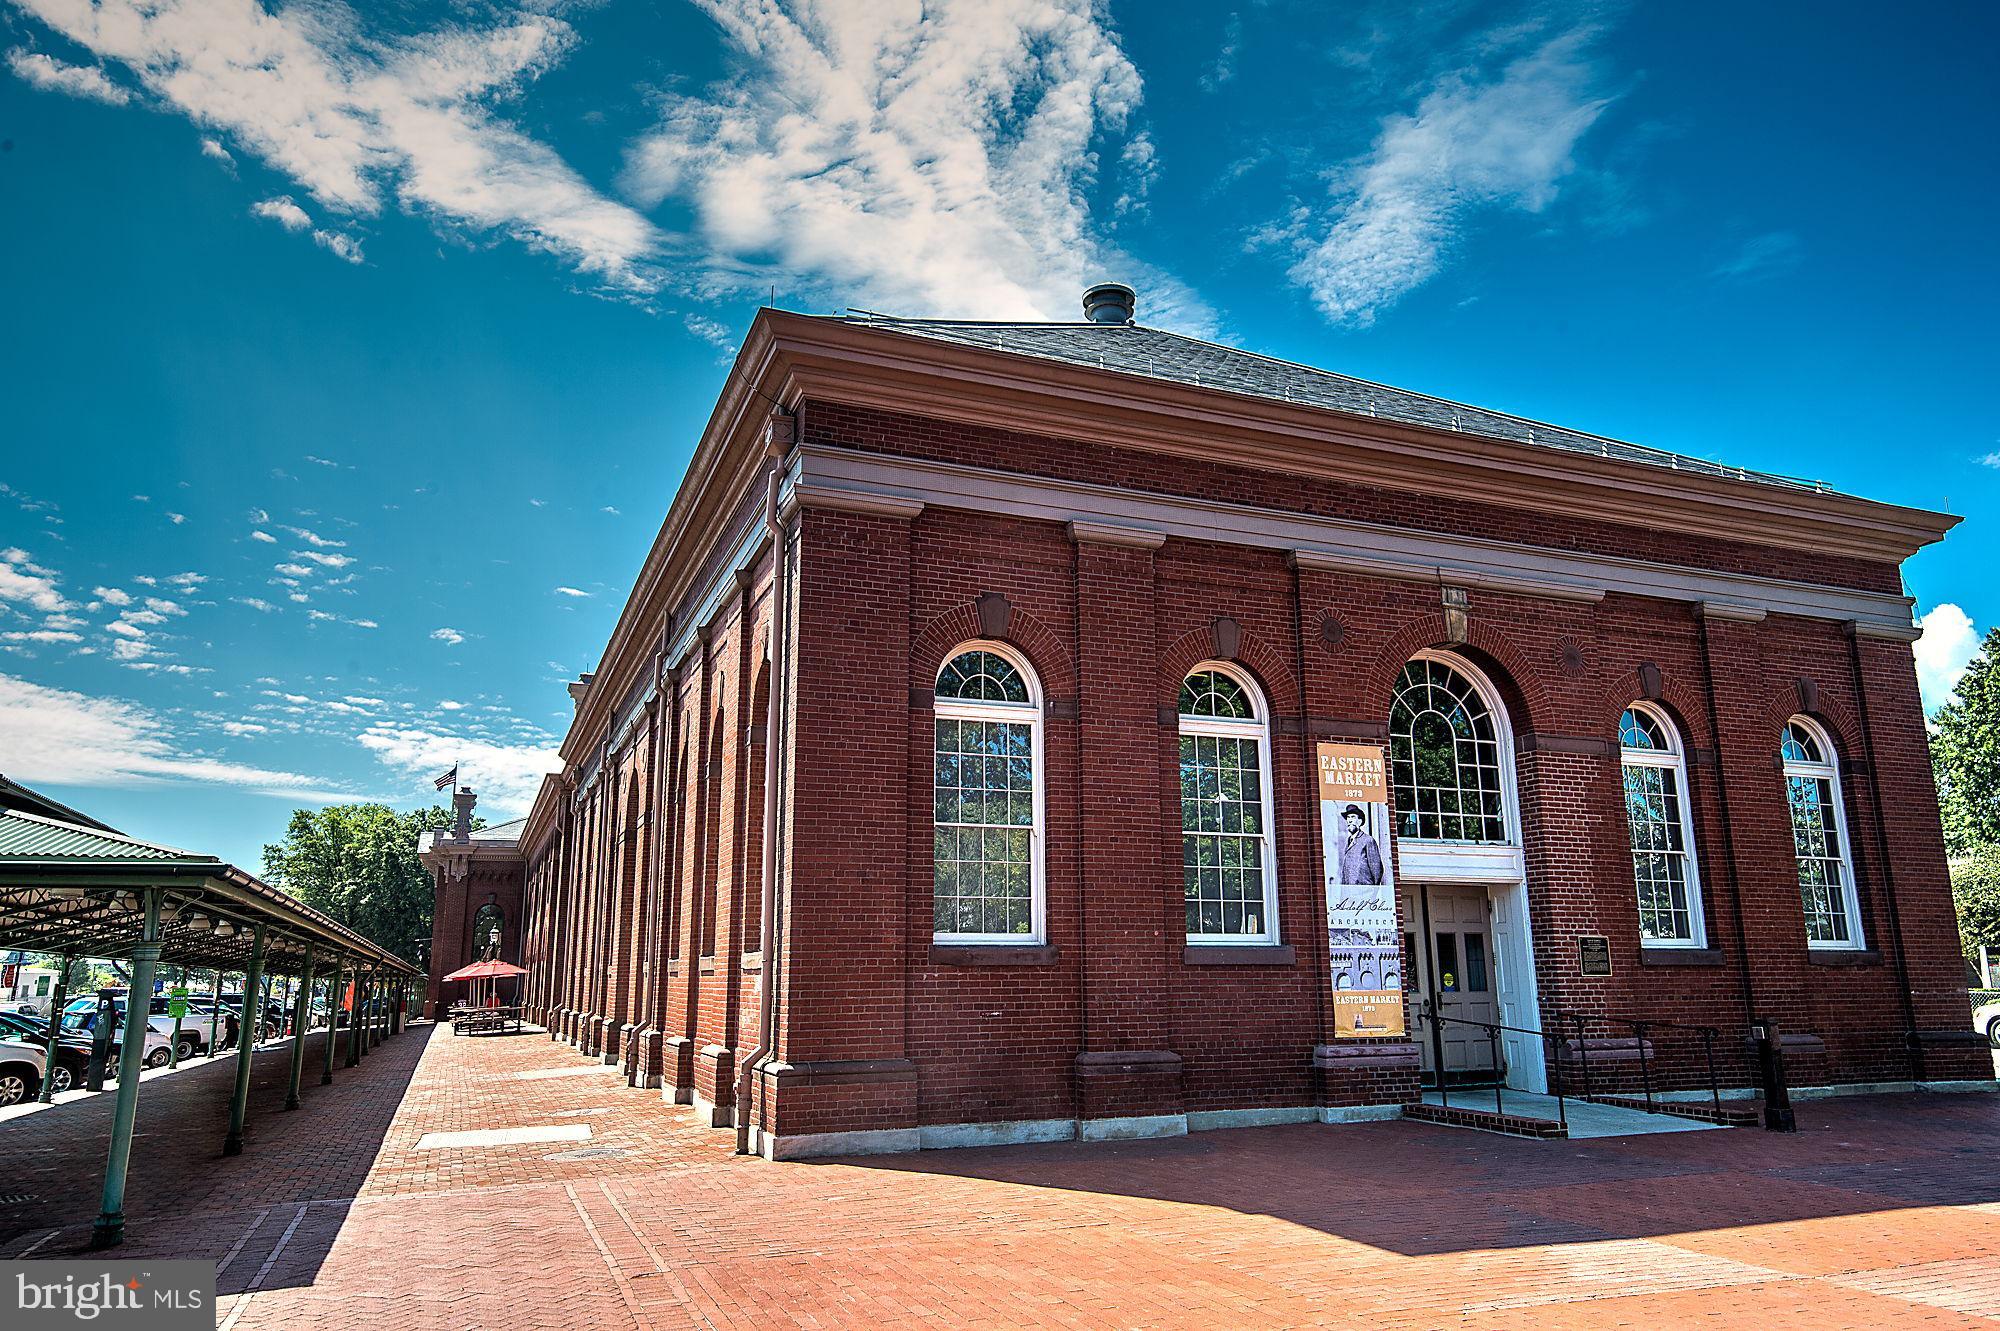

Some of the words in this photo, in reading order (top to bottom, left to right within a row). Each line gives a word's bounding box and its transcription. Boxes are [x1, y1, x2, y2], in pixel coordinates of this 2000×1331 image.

[1321, 755, 1382, 772] EASTERN
[1325, 771, 1381, 786] MARKET
[1344, 789, 1363, 798] 1873
[1335, 995, 1369, 1005] EASTERN
[1370, 995, 1400, 1004] MARKET
